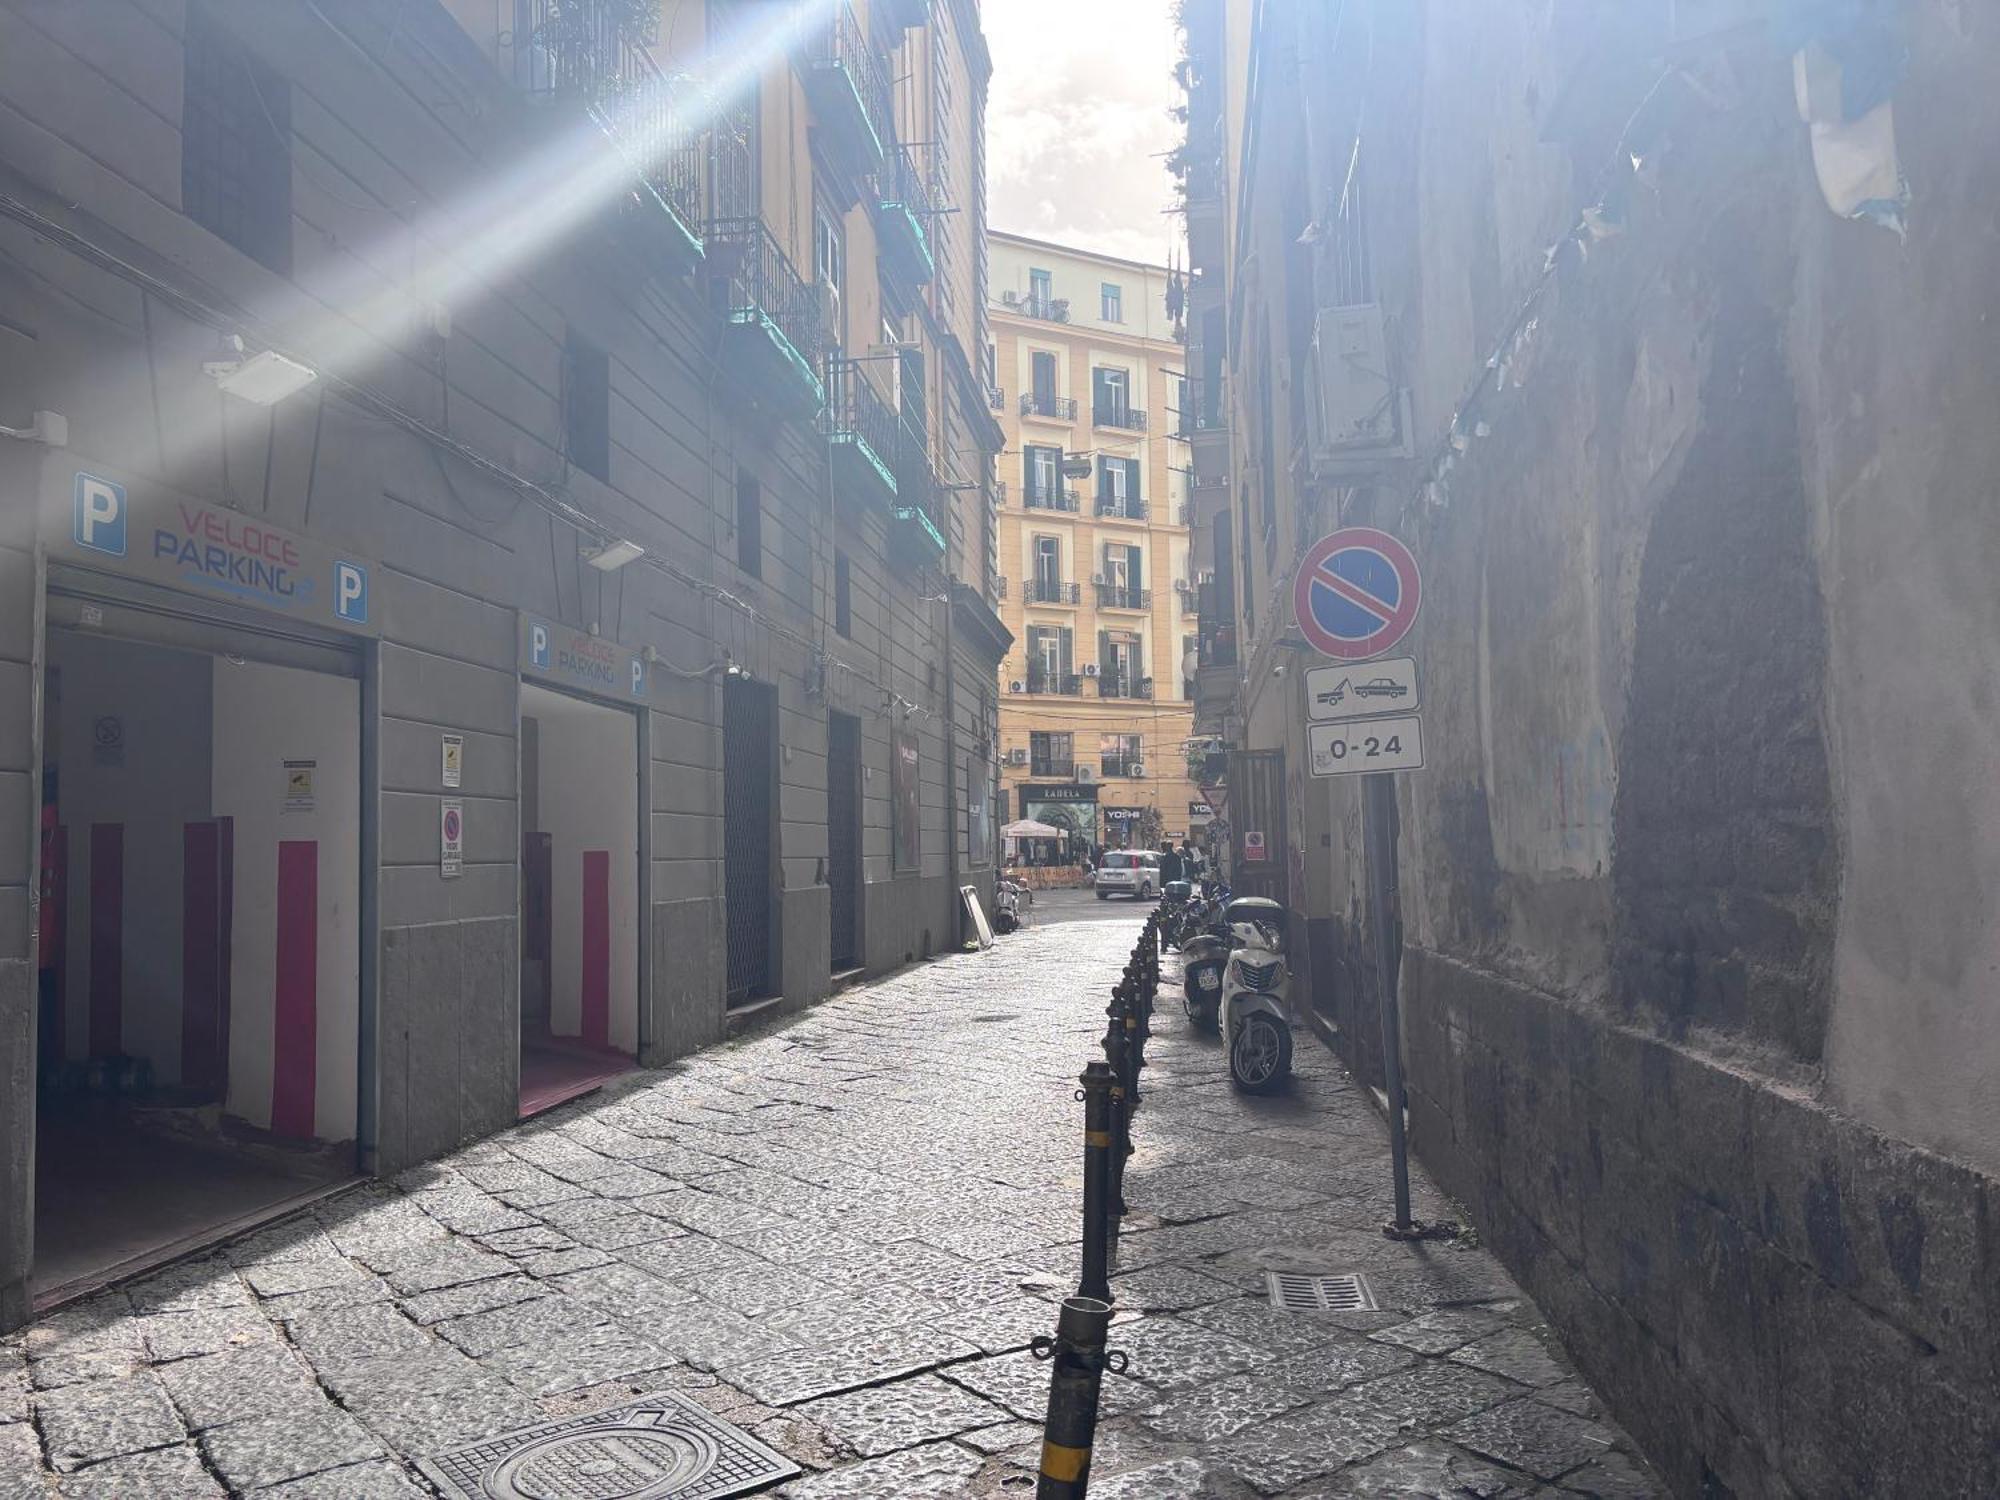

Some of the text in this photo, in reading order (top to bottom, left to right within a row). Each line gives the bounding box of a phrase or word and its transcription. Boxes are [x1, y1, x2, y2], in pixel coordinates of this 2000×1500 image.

[82, 477, 119, 544] P
[178, 502, 300, 568] VELOCE
[153, 529, 295, 596] PARKING
[339, 565, 362, 615] P
[532, 624, 547, 664] P
[559, 650, 615, 684] PARKING
[631, 659, 642, 692] P
[1330, 735, 1402, 760] 0-24
